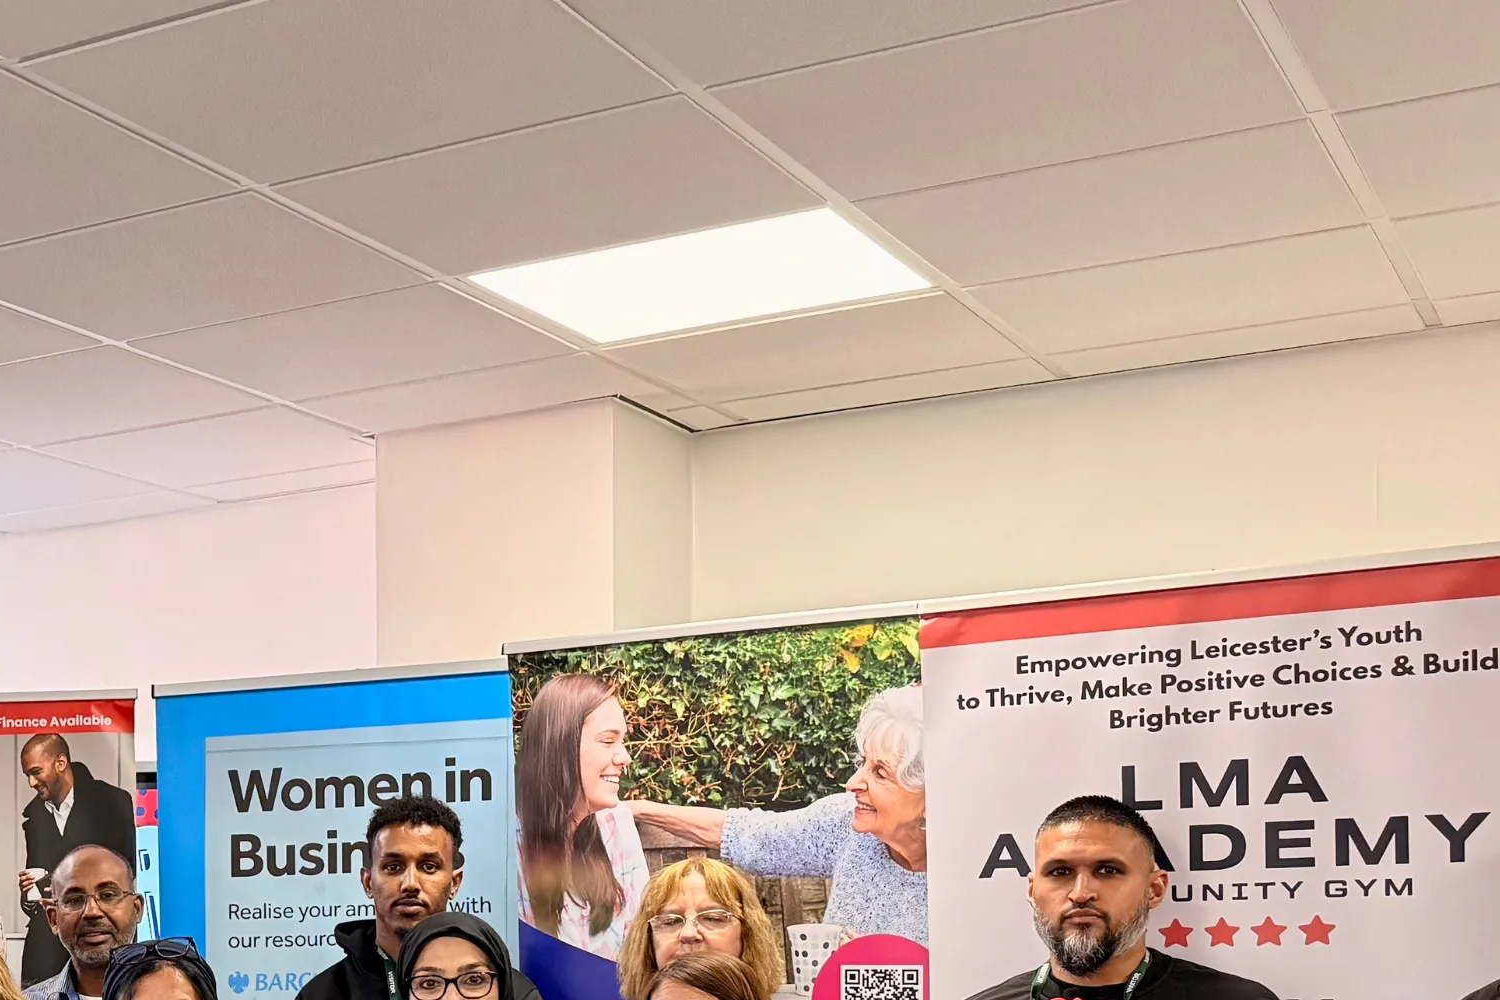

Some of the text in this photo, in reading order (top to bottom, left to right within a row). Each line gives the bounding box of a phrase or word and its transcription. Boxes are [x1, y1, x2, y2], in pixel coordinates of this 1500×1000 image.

[1016, 645, 1181, 677] Empowering
[1337, 621, 1422, 647] Youth
[957, 647, 1499, 710] to Thrive, Make Positive Choices & Build
[50, 714, 112, 727] Available
[1109, 700, 1333, 732] Brighter Futures
[227, 757, 493, 813] Women in
[1120, 755, 1329, 812] LMA
[230, 829, 465, 877] Busin
[979, 811, 1490, 880] ADEMY
[228, 903, 294, 920] Realise
[298, 904, 341, 927] your
[449, 897, 492, 913] with
[1171, 877, 1413, 903] UNITY GYM
[228, 932, 336, 949] our resourc
